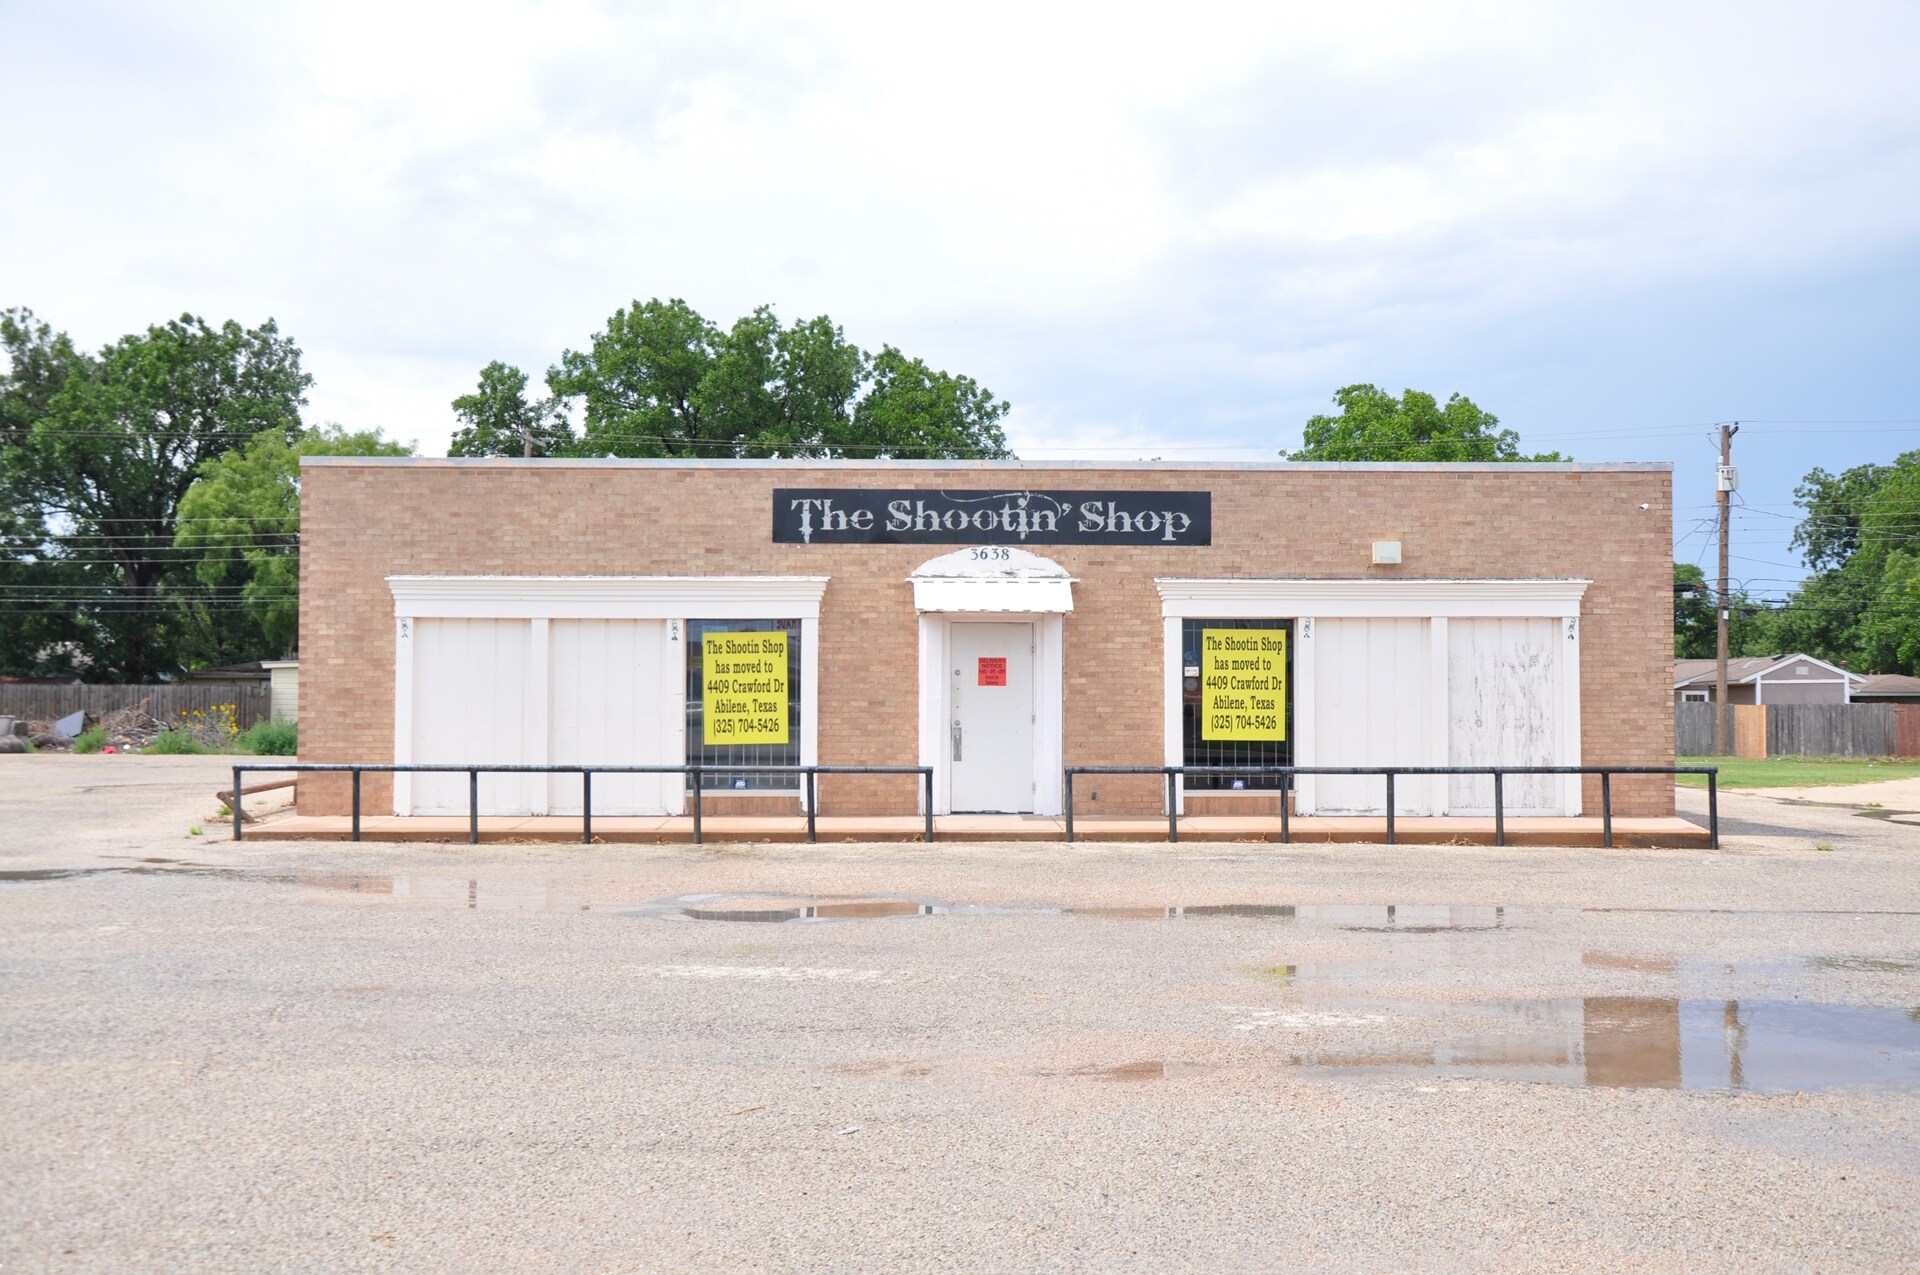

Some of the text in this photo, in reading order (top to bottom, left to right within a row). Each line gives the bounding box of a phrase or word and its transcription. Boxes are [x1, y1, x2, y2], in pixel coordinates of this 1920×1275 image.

[791, 492, 1192, 543] The Shootin' Shop
[970, 547, 1010, 560] 3638
[707, 639, 784, 657] The Shootin Shop
[1206, 636, 1283, 655] The Shootin Shop
[715, 659, 773, 674] has moved to
[1214, 656, 1272, 671] has moved to
[707, 679, 784, 694] 4409 Crawford Dr
[1206, 675, 1282, 691] 4409 Crawford Dr
[715, 699, 778, 715] Abilene, Texas
[1213, 695, 1275, 712] Abilene, Texas
[713, 718, 780, 737] (325) 704-5426
[1211, 715, 1277, 733] (325) 704-5426
